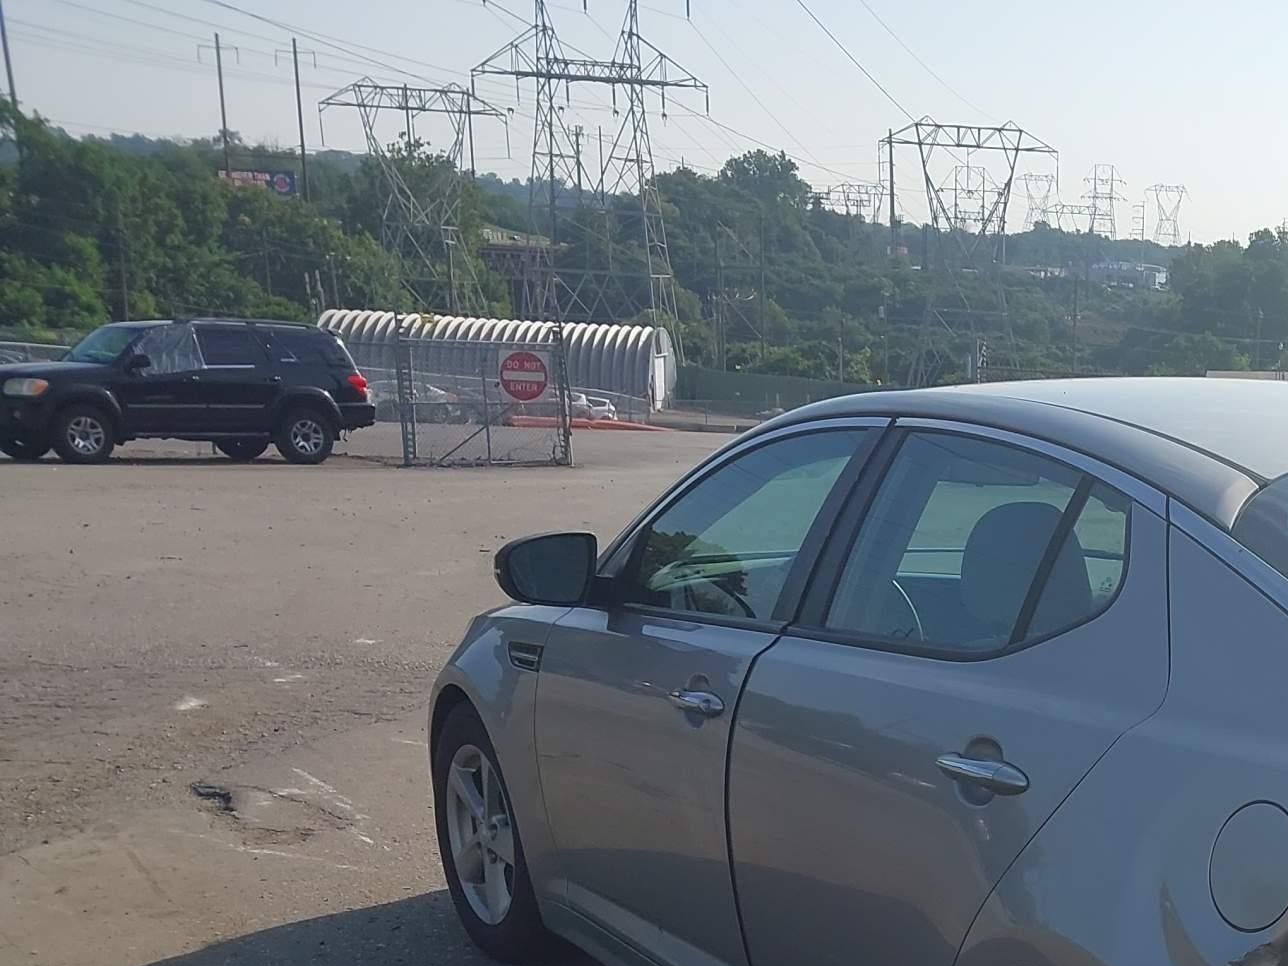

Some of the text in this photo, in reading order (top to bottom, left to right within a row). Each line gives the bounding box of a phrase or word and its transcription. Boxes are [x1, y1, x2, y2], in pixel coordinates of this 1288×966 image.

[506, 360, 541, 369] DO NOT
[510, 382, 538, 392] ENTER
